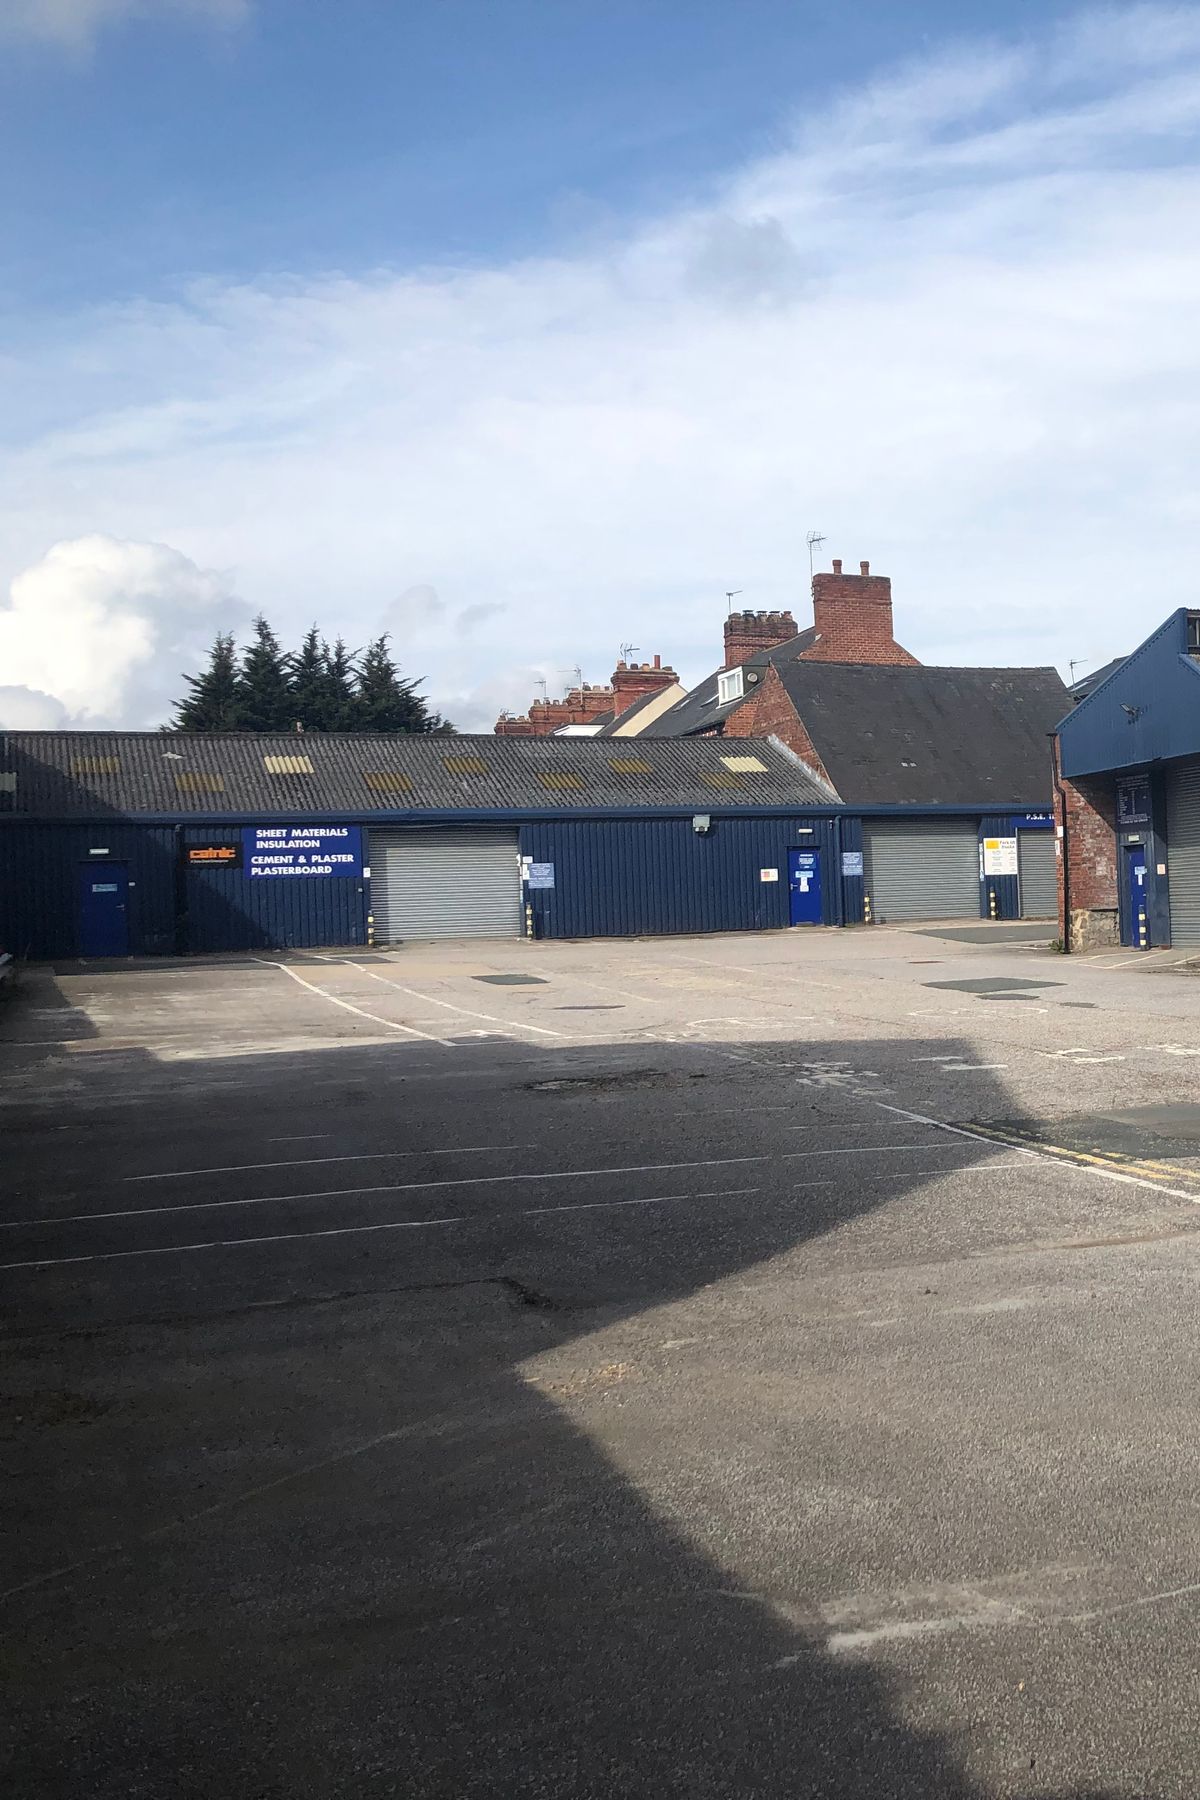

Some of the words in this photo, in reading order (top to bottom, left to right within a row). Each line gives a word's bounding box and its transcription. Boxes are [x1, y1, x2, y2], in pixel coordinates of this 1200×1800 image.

[256, 829, 287, 838] SHEET
[291, 828, 348, 837] MATERIALS
[256, 840, 320, 849] INSULATION
[251, 855, 294, 864] CEMENT
[298, 855, 307, 864] &
[311, 854, 354, 863] PLASTER
[251, 866, 332, 876] PLASTERBOARD
